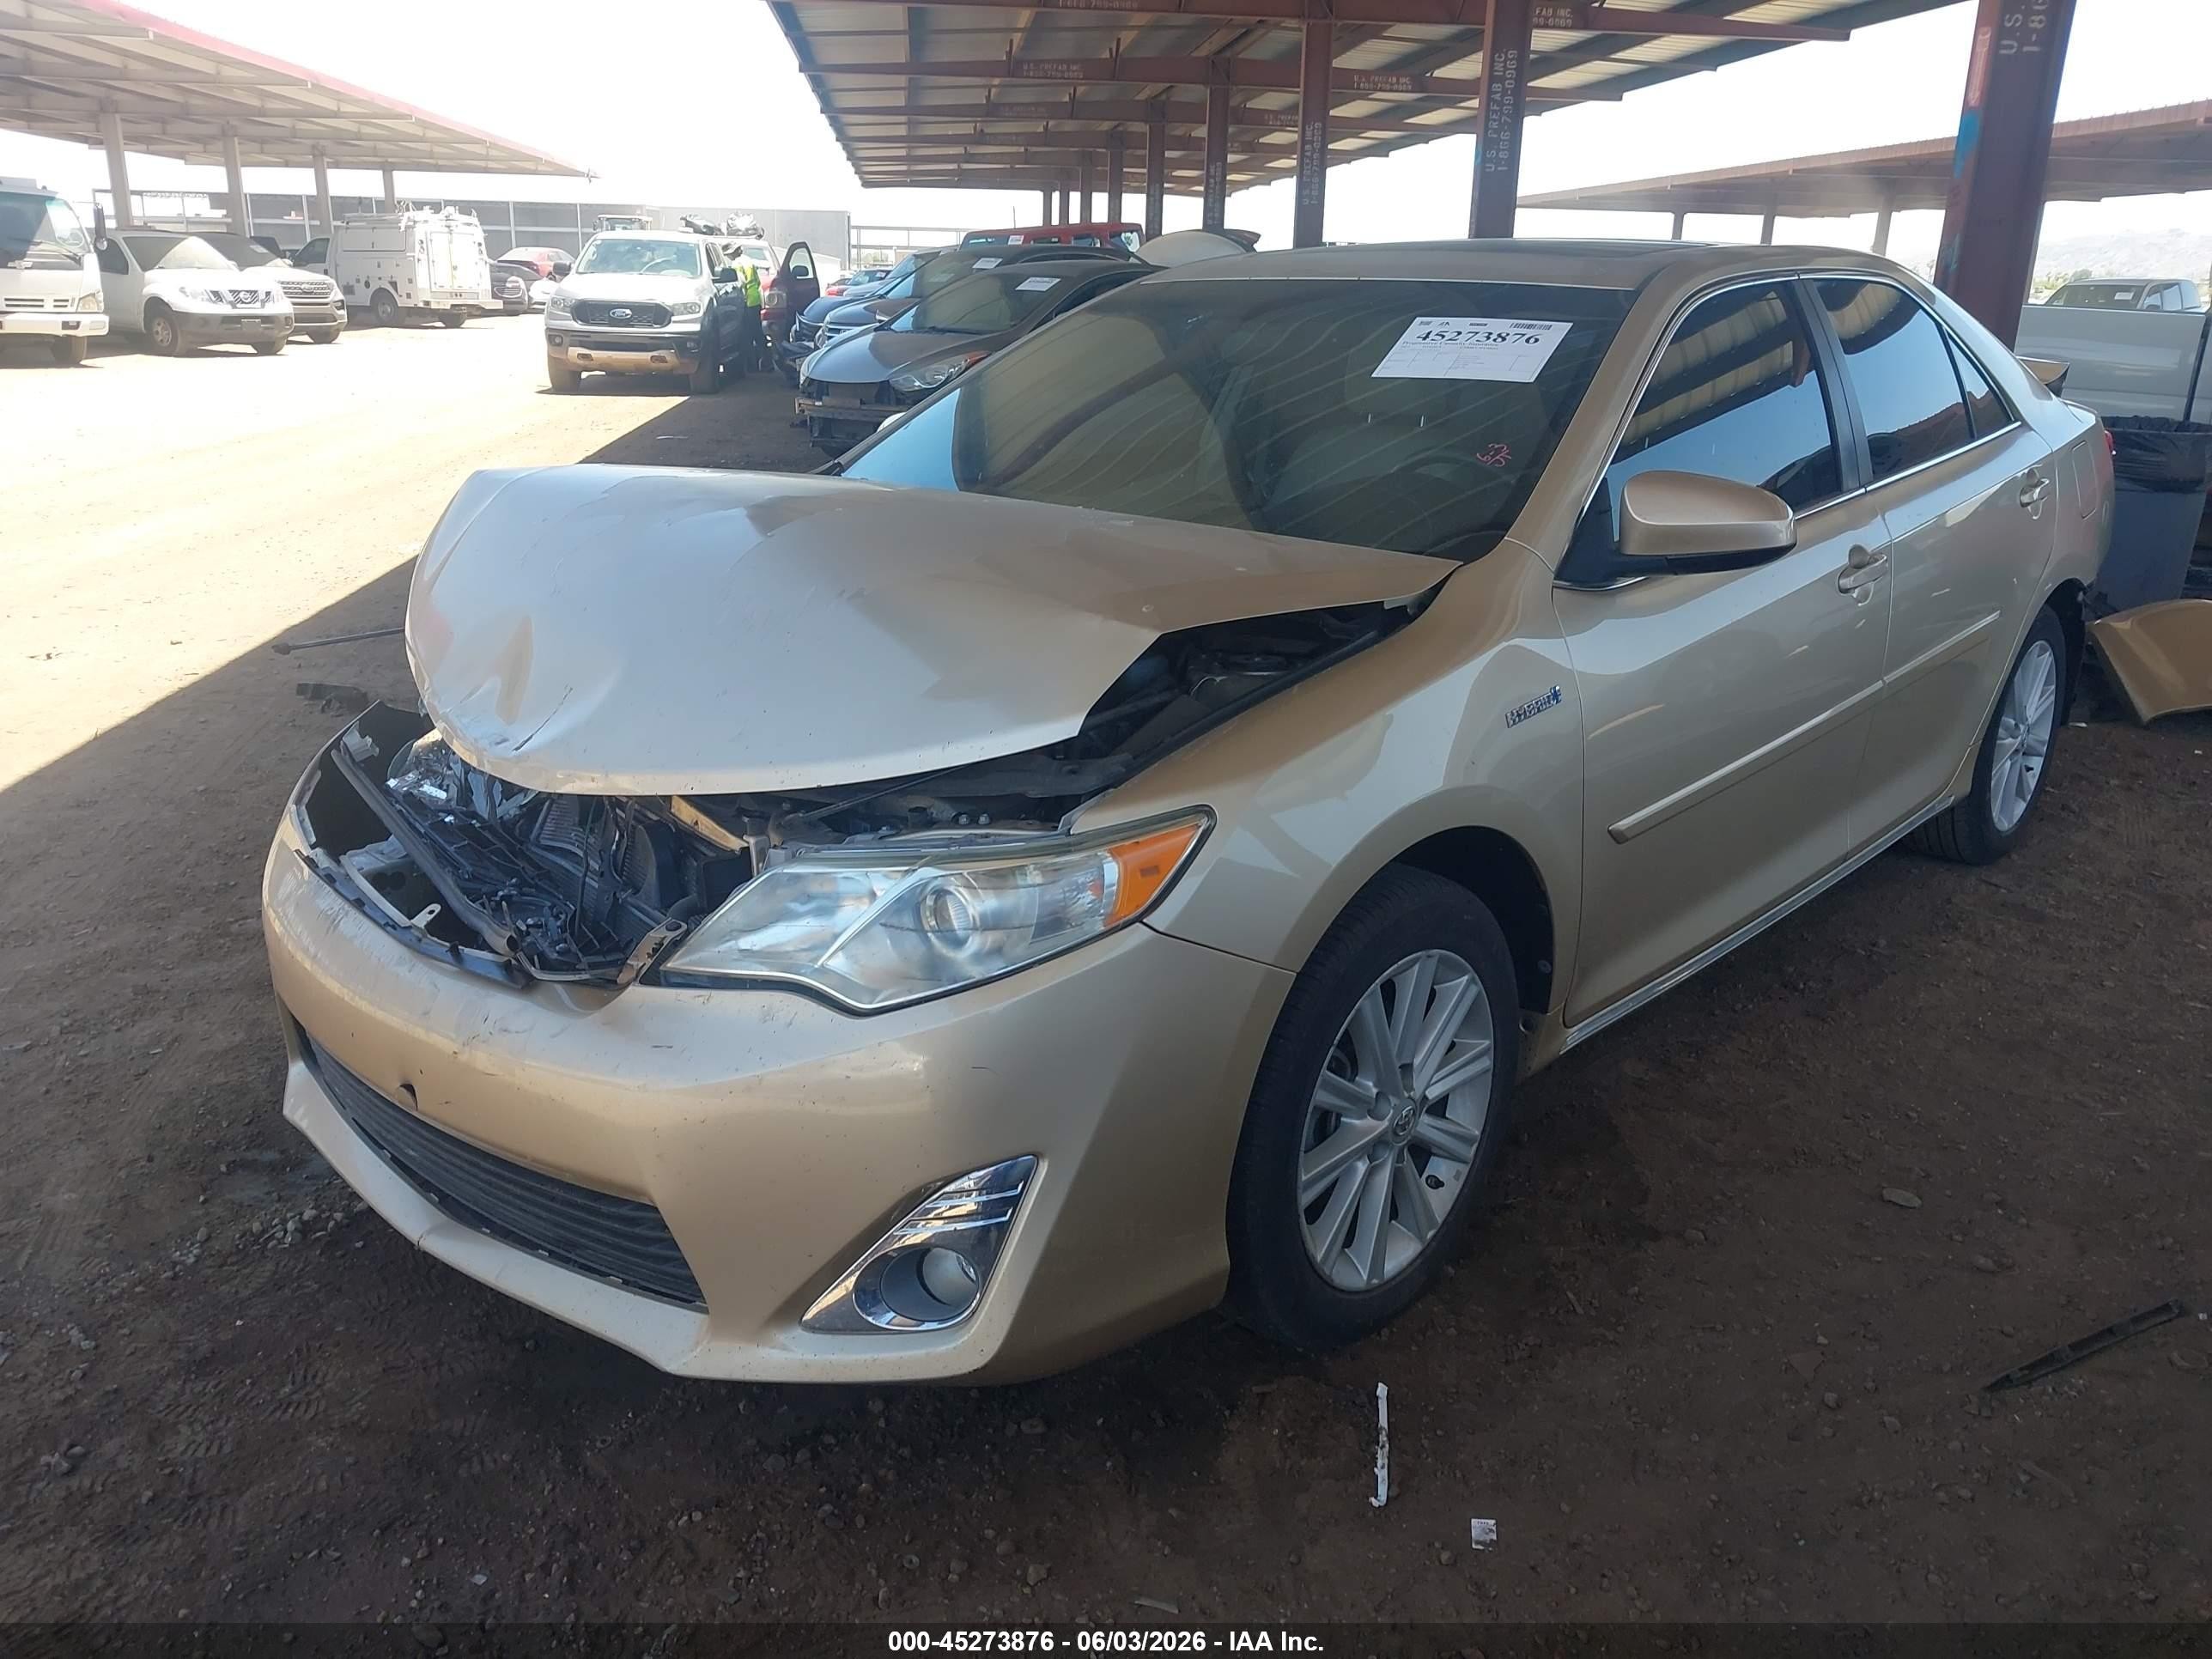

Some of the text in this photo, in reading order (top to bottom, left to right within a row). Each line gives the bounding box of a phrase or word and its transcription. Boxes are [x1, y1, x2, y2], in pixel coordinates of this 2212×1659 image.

[1998, 4, 2026, 55] U.S.
[1493, 48, 1507, 76] INC.
[1487, 82, 1503, 138] PREFAB
[1415, 330, 1542, 344] 45273876
[1505, 692, 1553, 728] HYBRID
